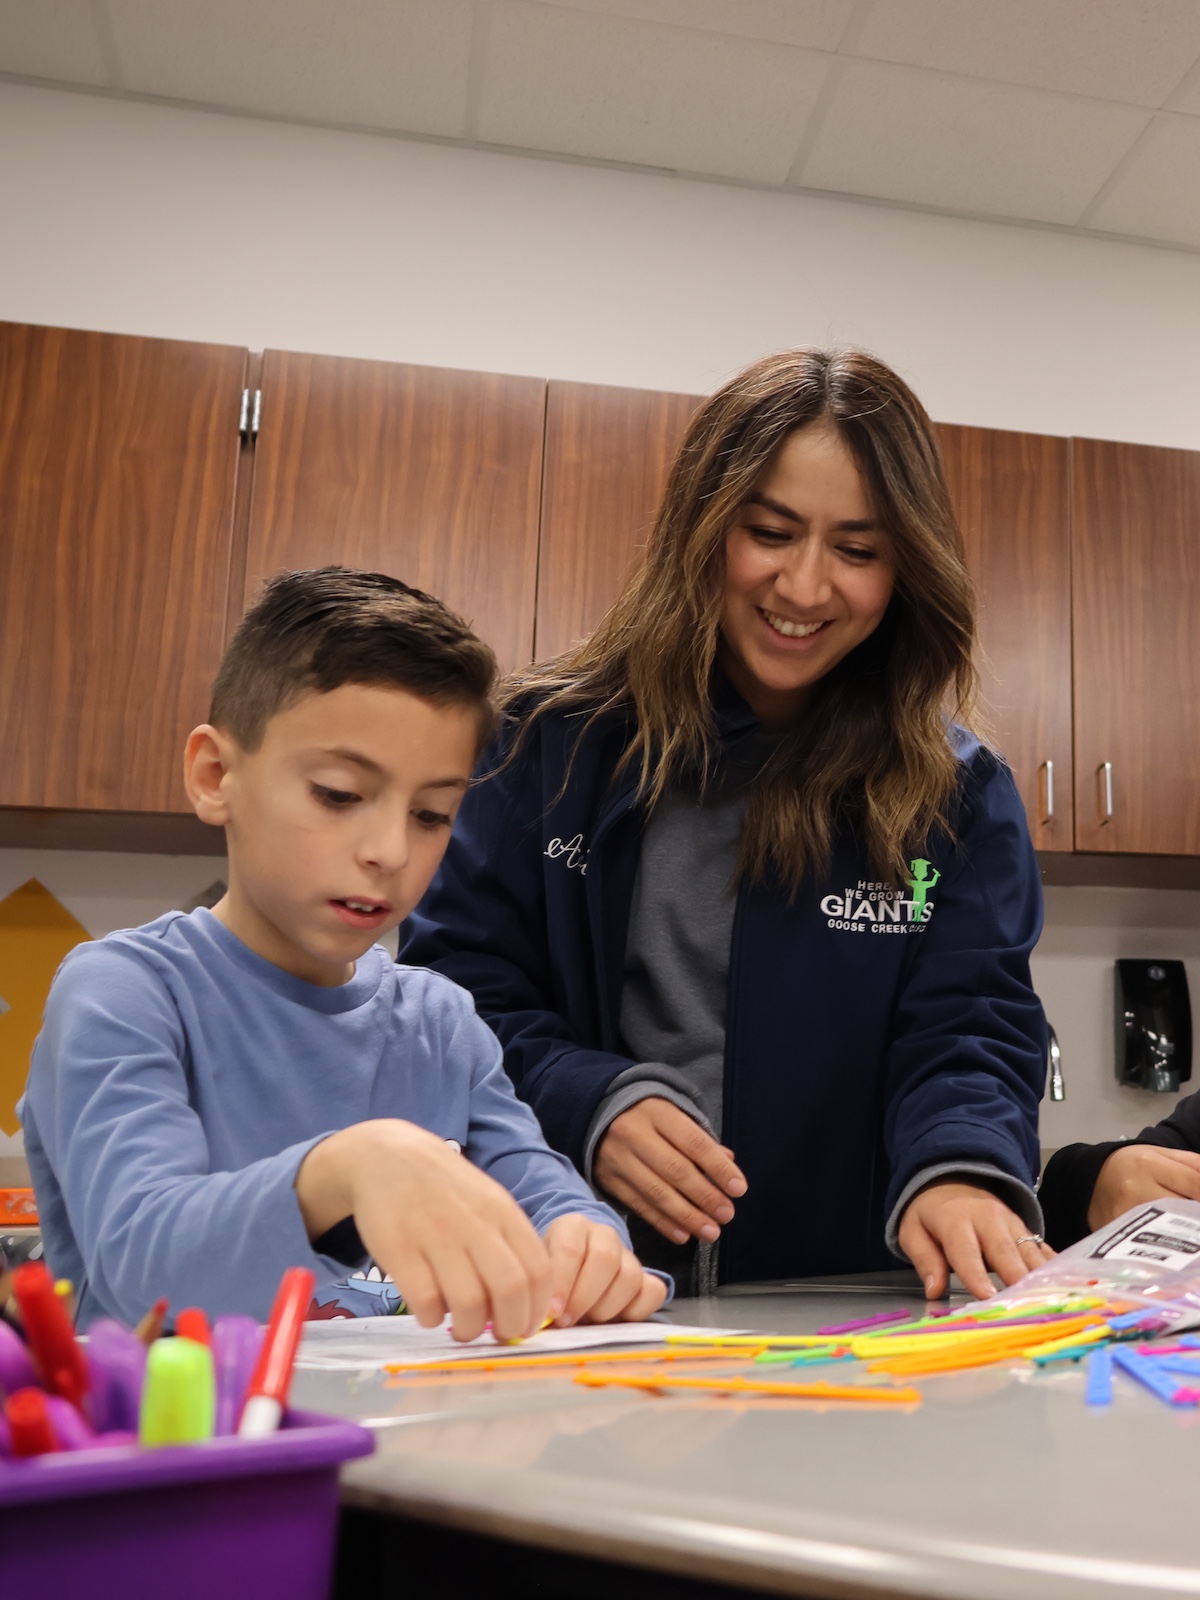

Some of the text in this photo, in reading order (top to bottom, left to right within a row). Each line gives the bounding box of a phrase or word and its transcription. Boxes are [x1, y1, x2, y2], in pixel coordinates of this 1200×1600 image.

[844, 887, 905, 902] WE GROW
[819, 894, 935, 923] GIANTS
[827, 918, 867, 933] GOOSE
[870, 923, 909, 934] CREEK
